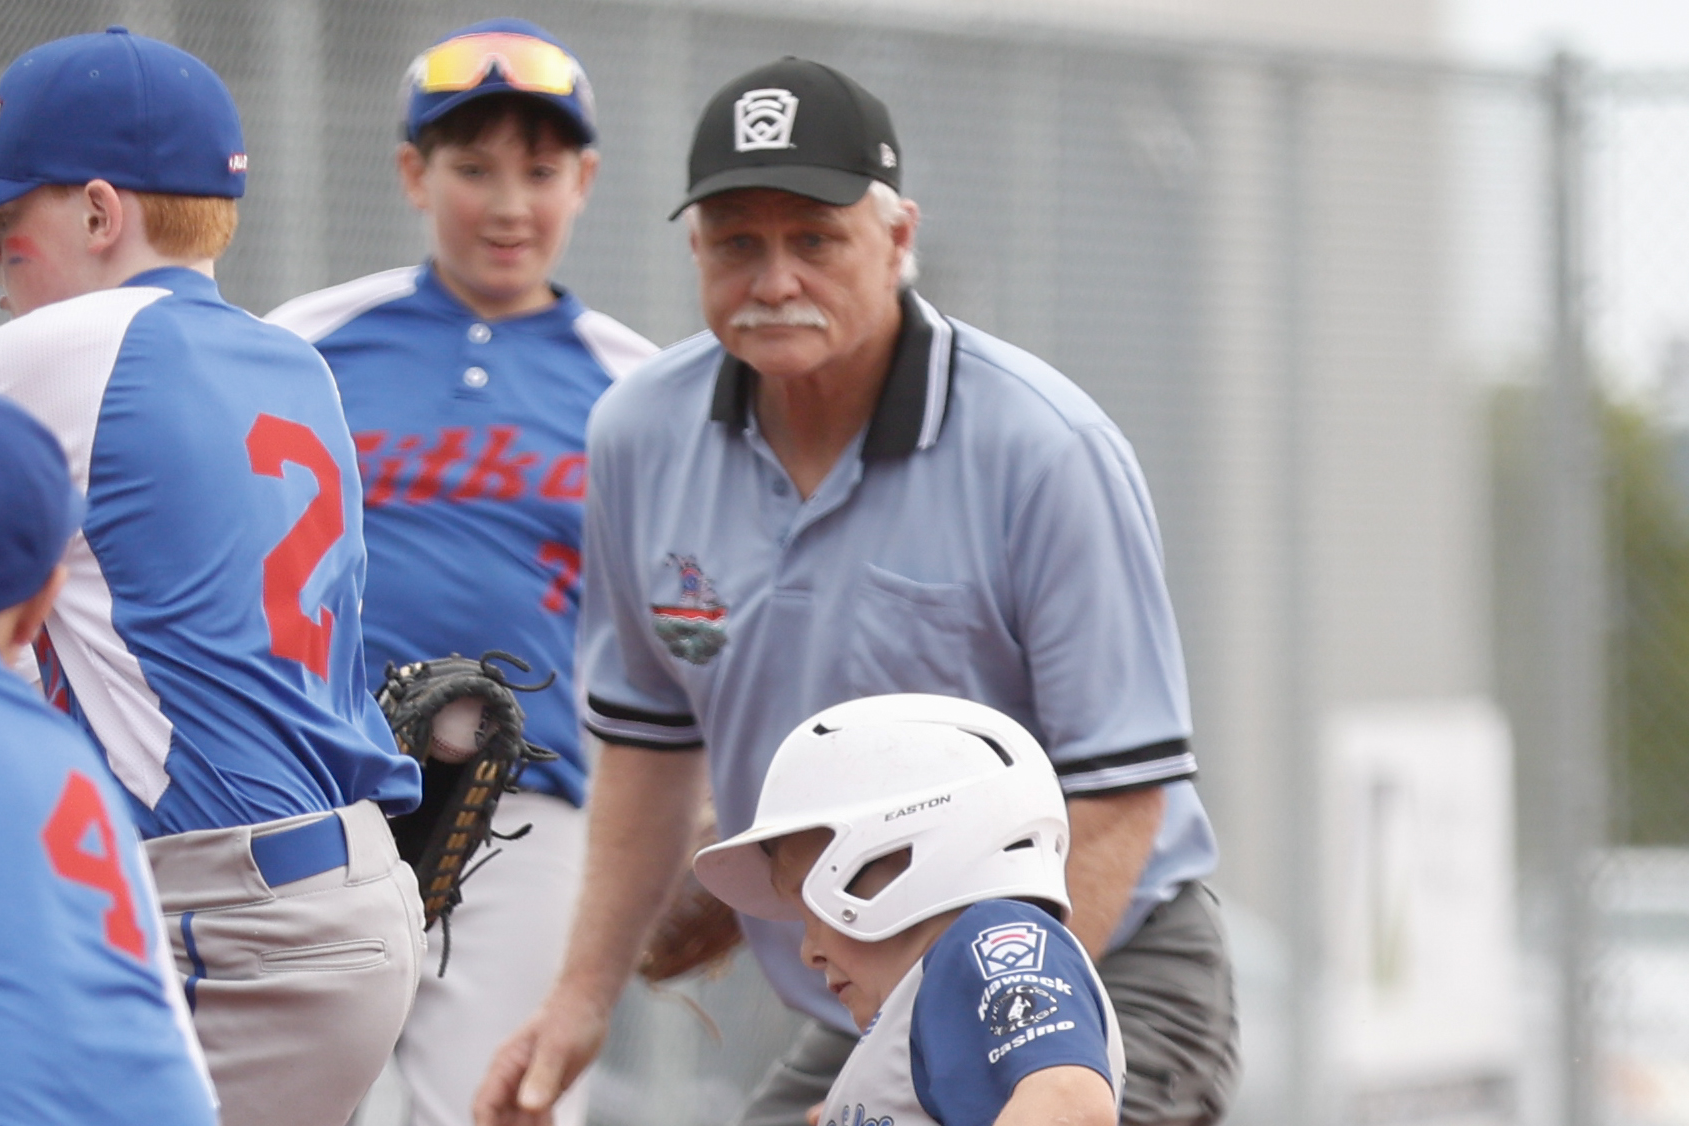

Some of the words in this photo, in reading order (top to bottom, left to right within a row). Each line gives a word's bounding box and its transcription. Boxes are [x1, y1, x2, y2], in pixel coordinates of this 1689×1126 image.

[245, 412, 344, 684] 2
[39, 768, 148, 963] 4
[884, 794, 951, 822] EASTON
